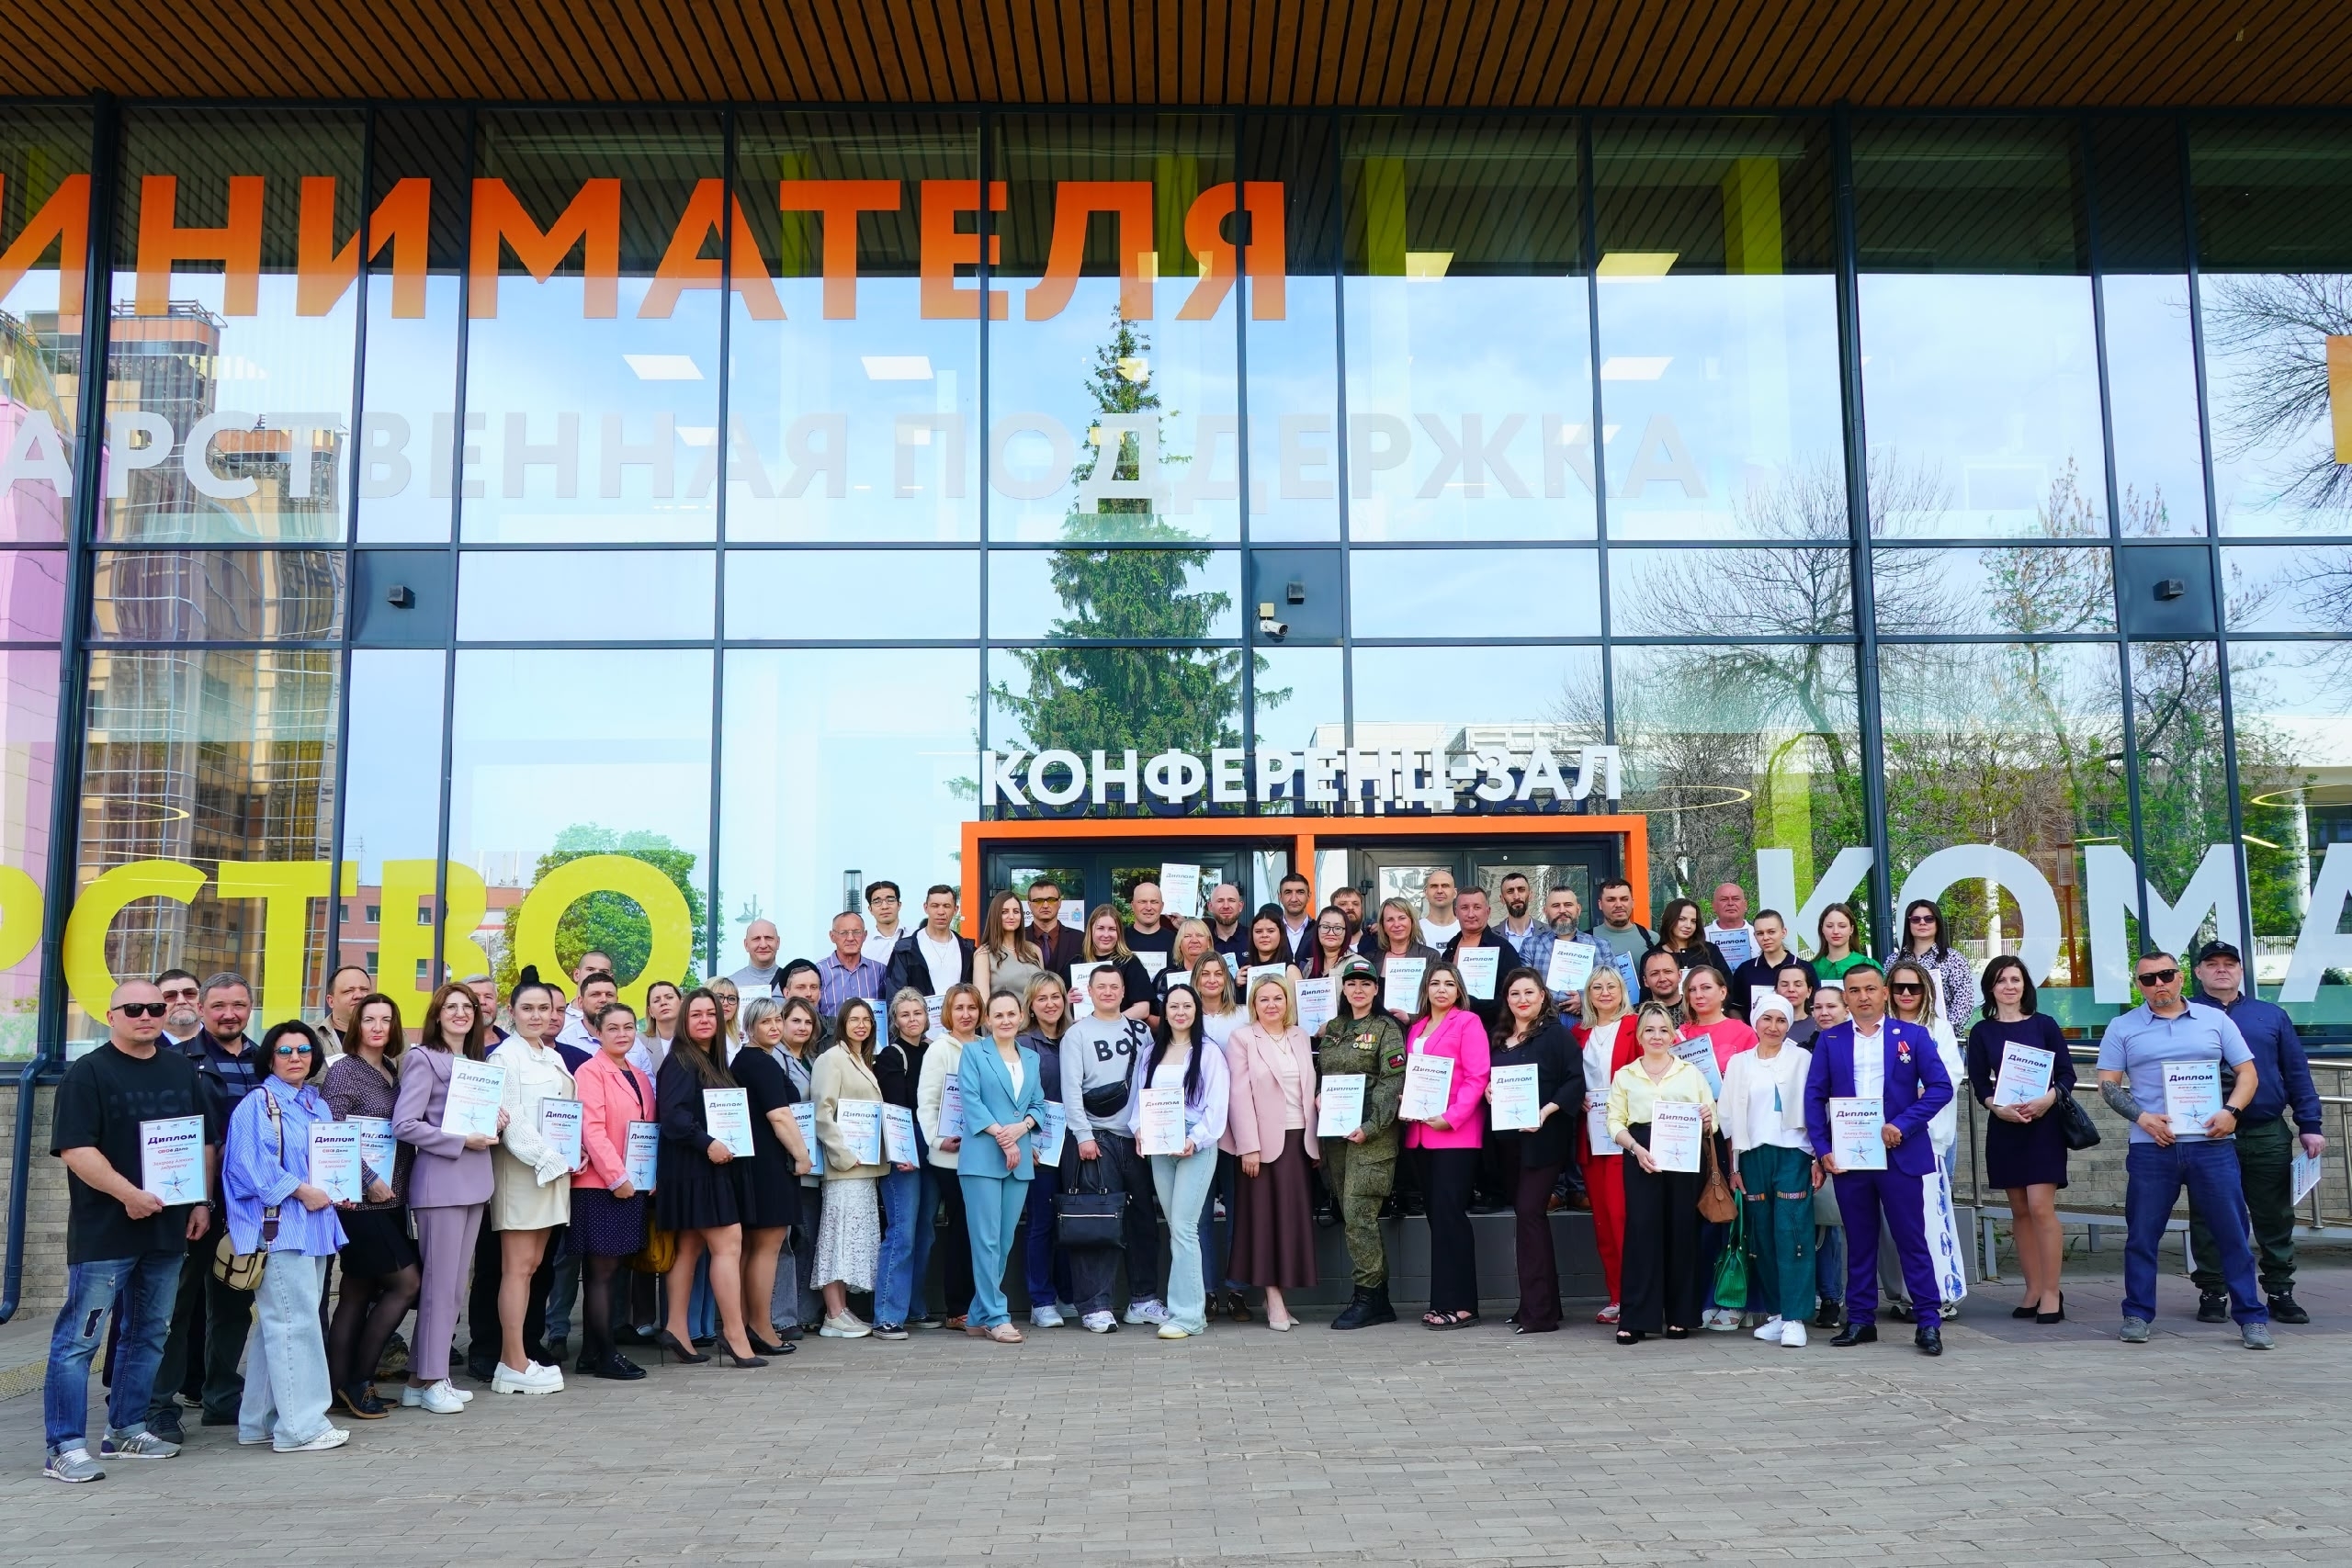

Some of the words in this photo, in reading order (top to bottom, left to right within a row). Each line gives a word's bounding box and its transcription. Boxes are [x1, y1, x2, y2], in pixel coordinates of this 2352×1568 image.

[0, 410, 847, 499] АРСТВЕННАЯ
[894, 412, 1707, 514] ПОДДЕРЖКА
[982, 745, 1622, 810] КОНФЕРЕНЦ-ЗАЛ
[2007, 1054, 2047, 1068] Диплом
[458, 1073, 500, 1086] Диплом
[1497, 1076, 1532, 1084] Диплом
[545, 1111, 578, 1120] Диплом
[842, 1111, 878, 1119] Диплом
[1658, 1113, 1697, 1122] Диплом
[147, 1133, 197, 1145] Диплом
